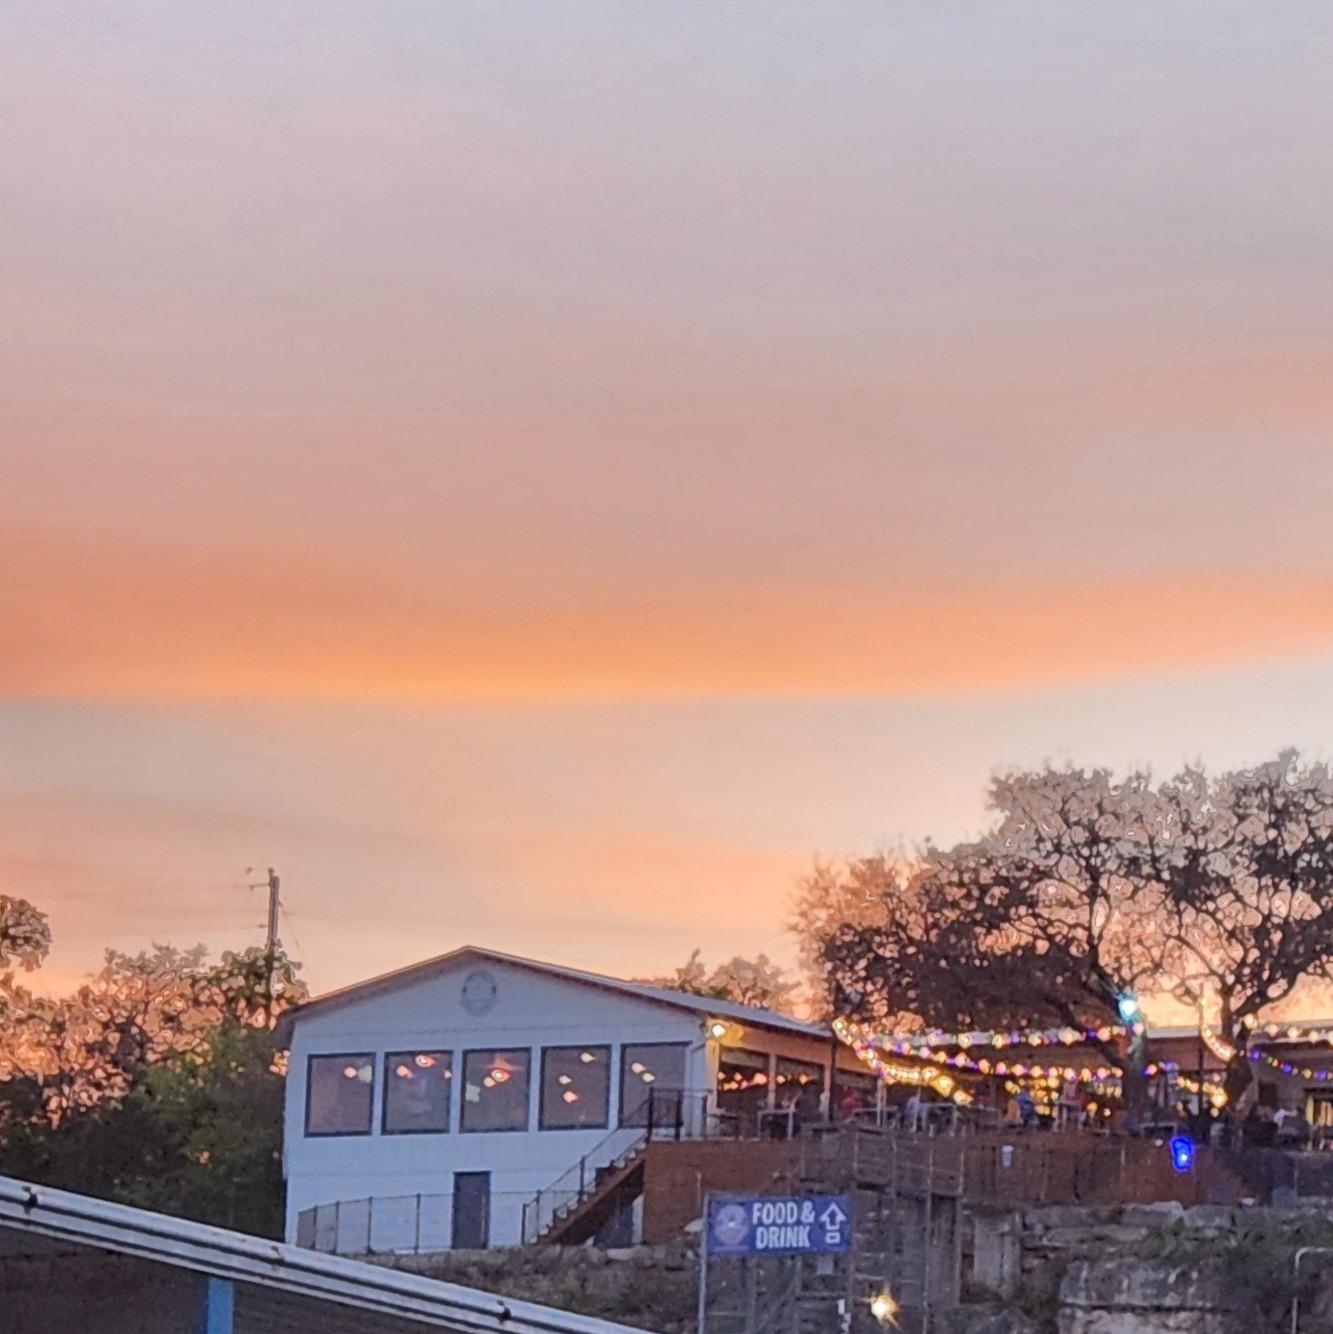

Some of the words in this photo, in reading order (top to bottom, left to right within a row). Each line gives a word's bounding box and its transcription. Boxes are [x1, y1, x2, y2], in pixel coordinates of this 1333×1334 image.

[752, 1202, 798, 1225] FOOD
[801, 1200, 815, 1223] &
[755, 1226, 811, 1249] DRINK
